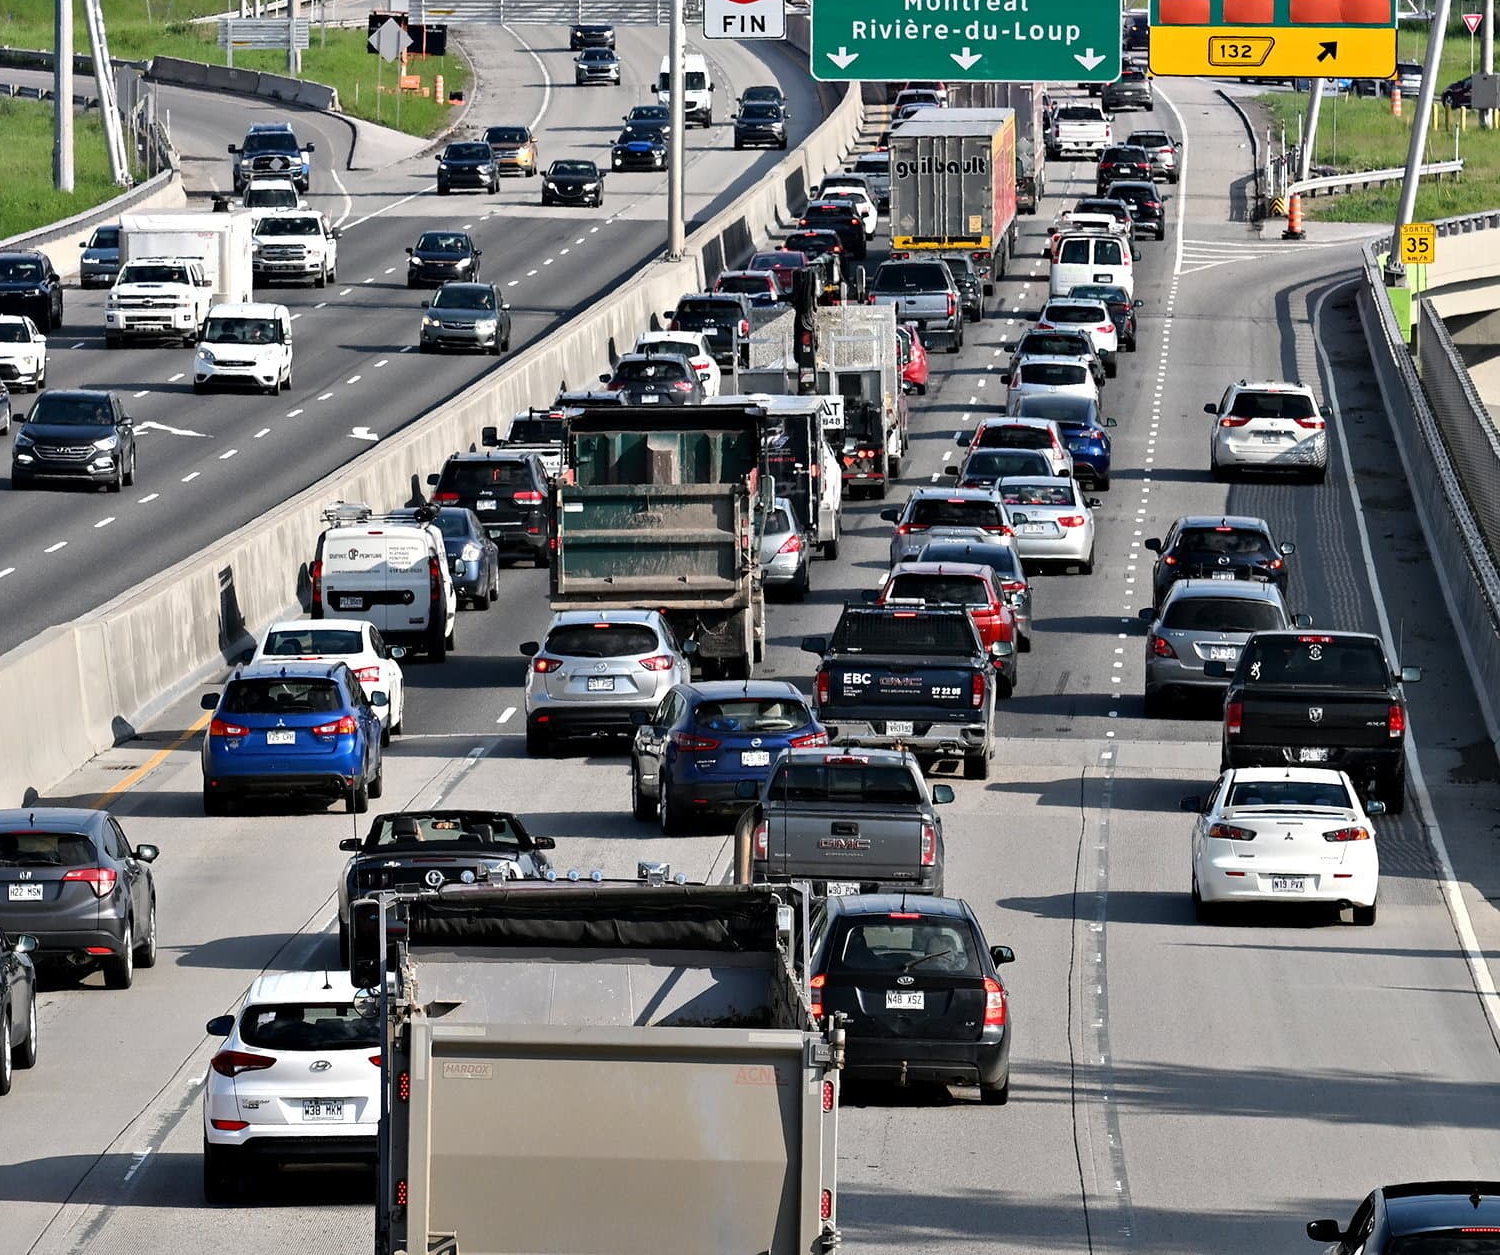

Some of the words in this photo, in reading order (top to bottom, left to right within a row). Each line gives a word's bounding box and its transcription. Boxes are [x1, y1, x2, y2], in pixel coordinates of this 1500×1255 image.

[722, 15, 766, 33] FIN
[852, 19, 1080, 45] Rivière-du-Loup
[1220, 44, 1252, 58] 132
[895, 155, 987, 179] guilbault
[1406, 237, 1429, 253] 35
[843, 673, 871, 685] EBC
[879, 676, 923, 686] GMC
[818, 837, 871, 850] GMC
[1274, 880, 1287, 889] N19
[10, 887, 23, 897] H22
[27, 887, 41, 897] MSN
[445, 1064, 490, 1074] HARDOX
